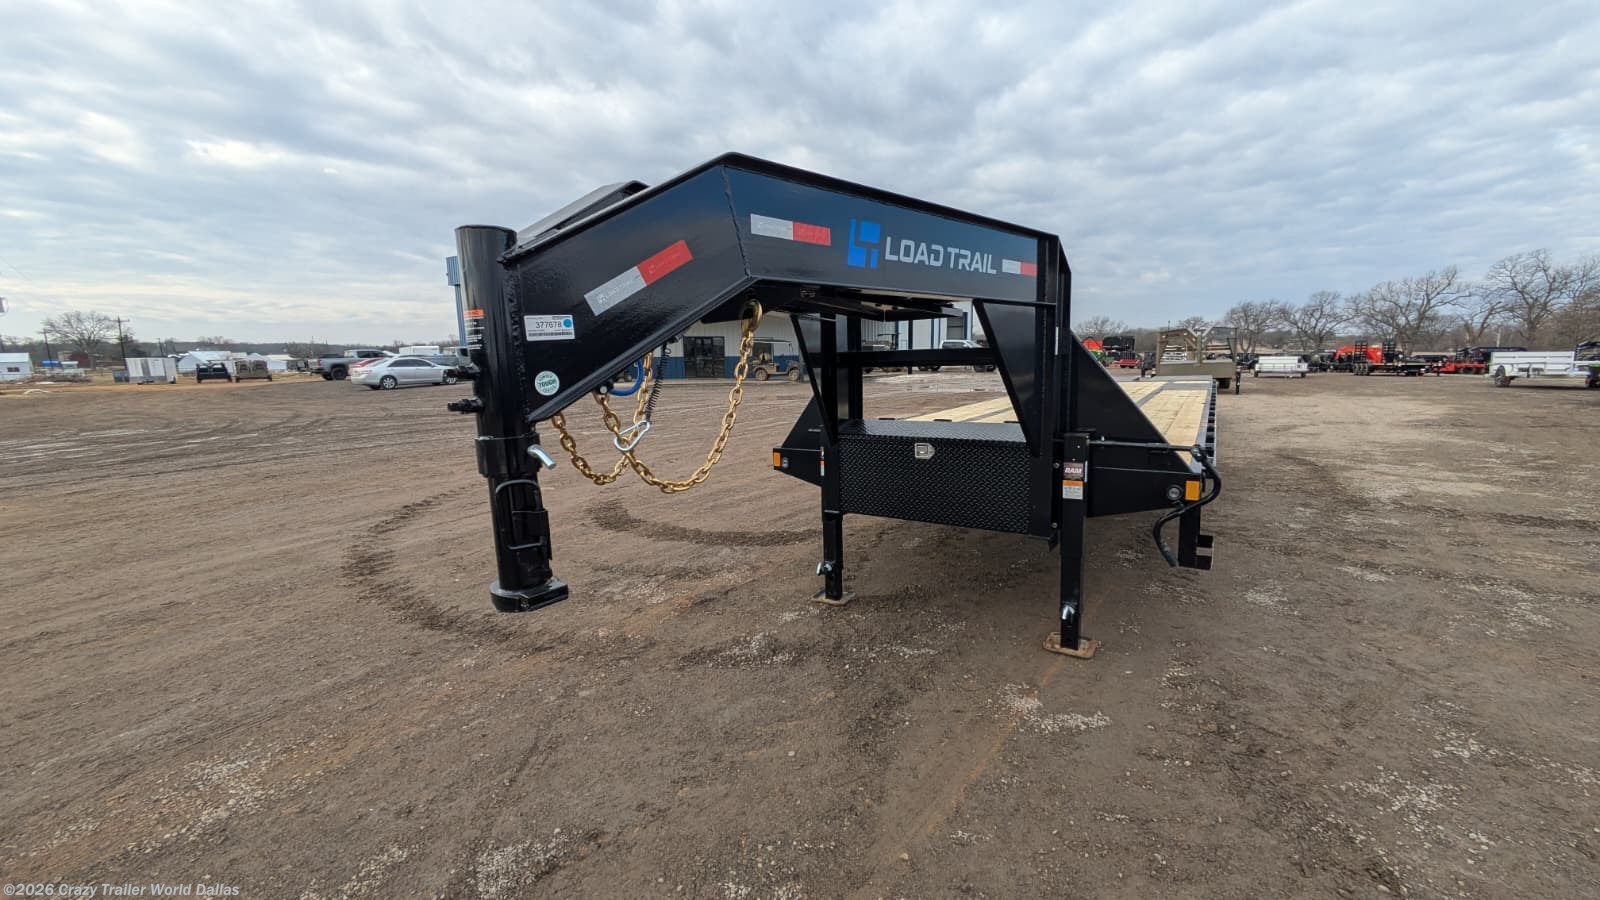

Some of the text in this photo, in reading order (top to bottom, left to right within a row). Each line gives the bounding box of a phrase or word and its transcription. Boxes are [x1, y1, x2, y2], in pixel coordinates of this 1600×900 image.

[885, 236, 997, 275] LOAD TRAIL
[535, 320, 562, 329] 377678
